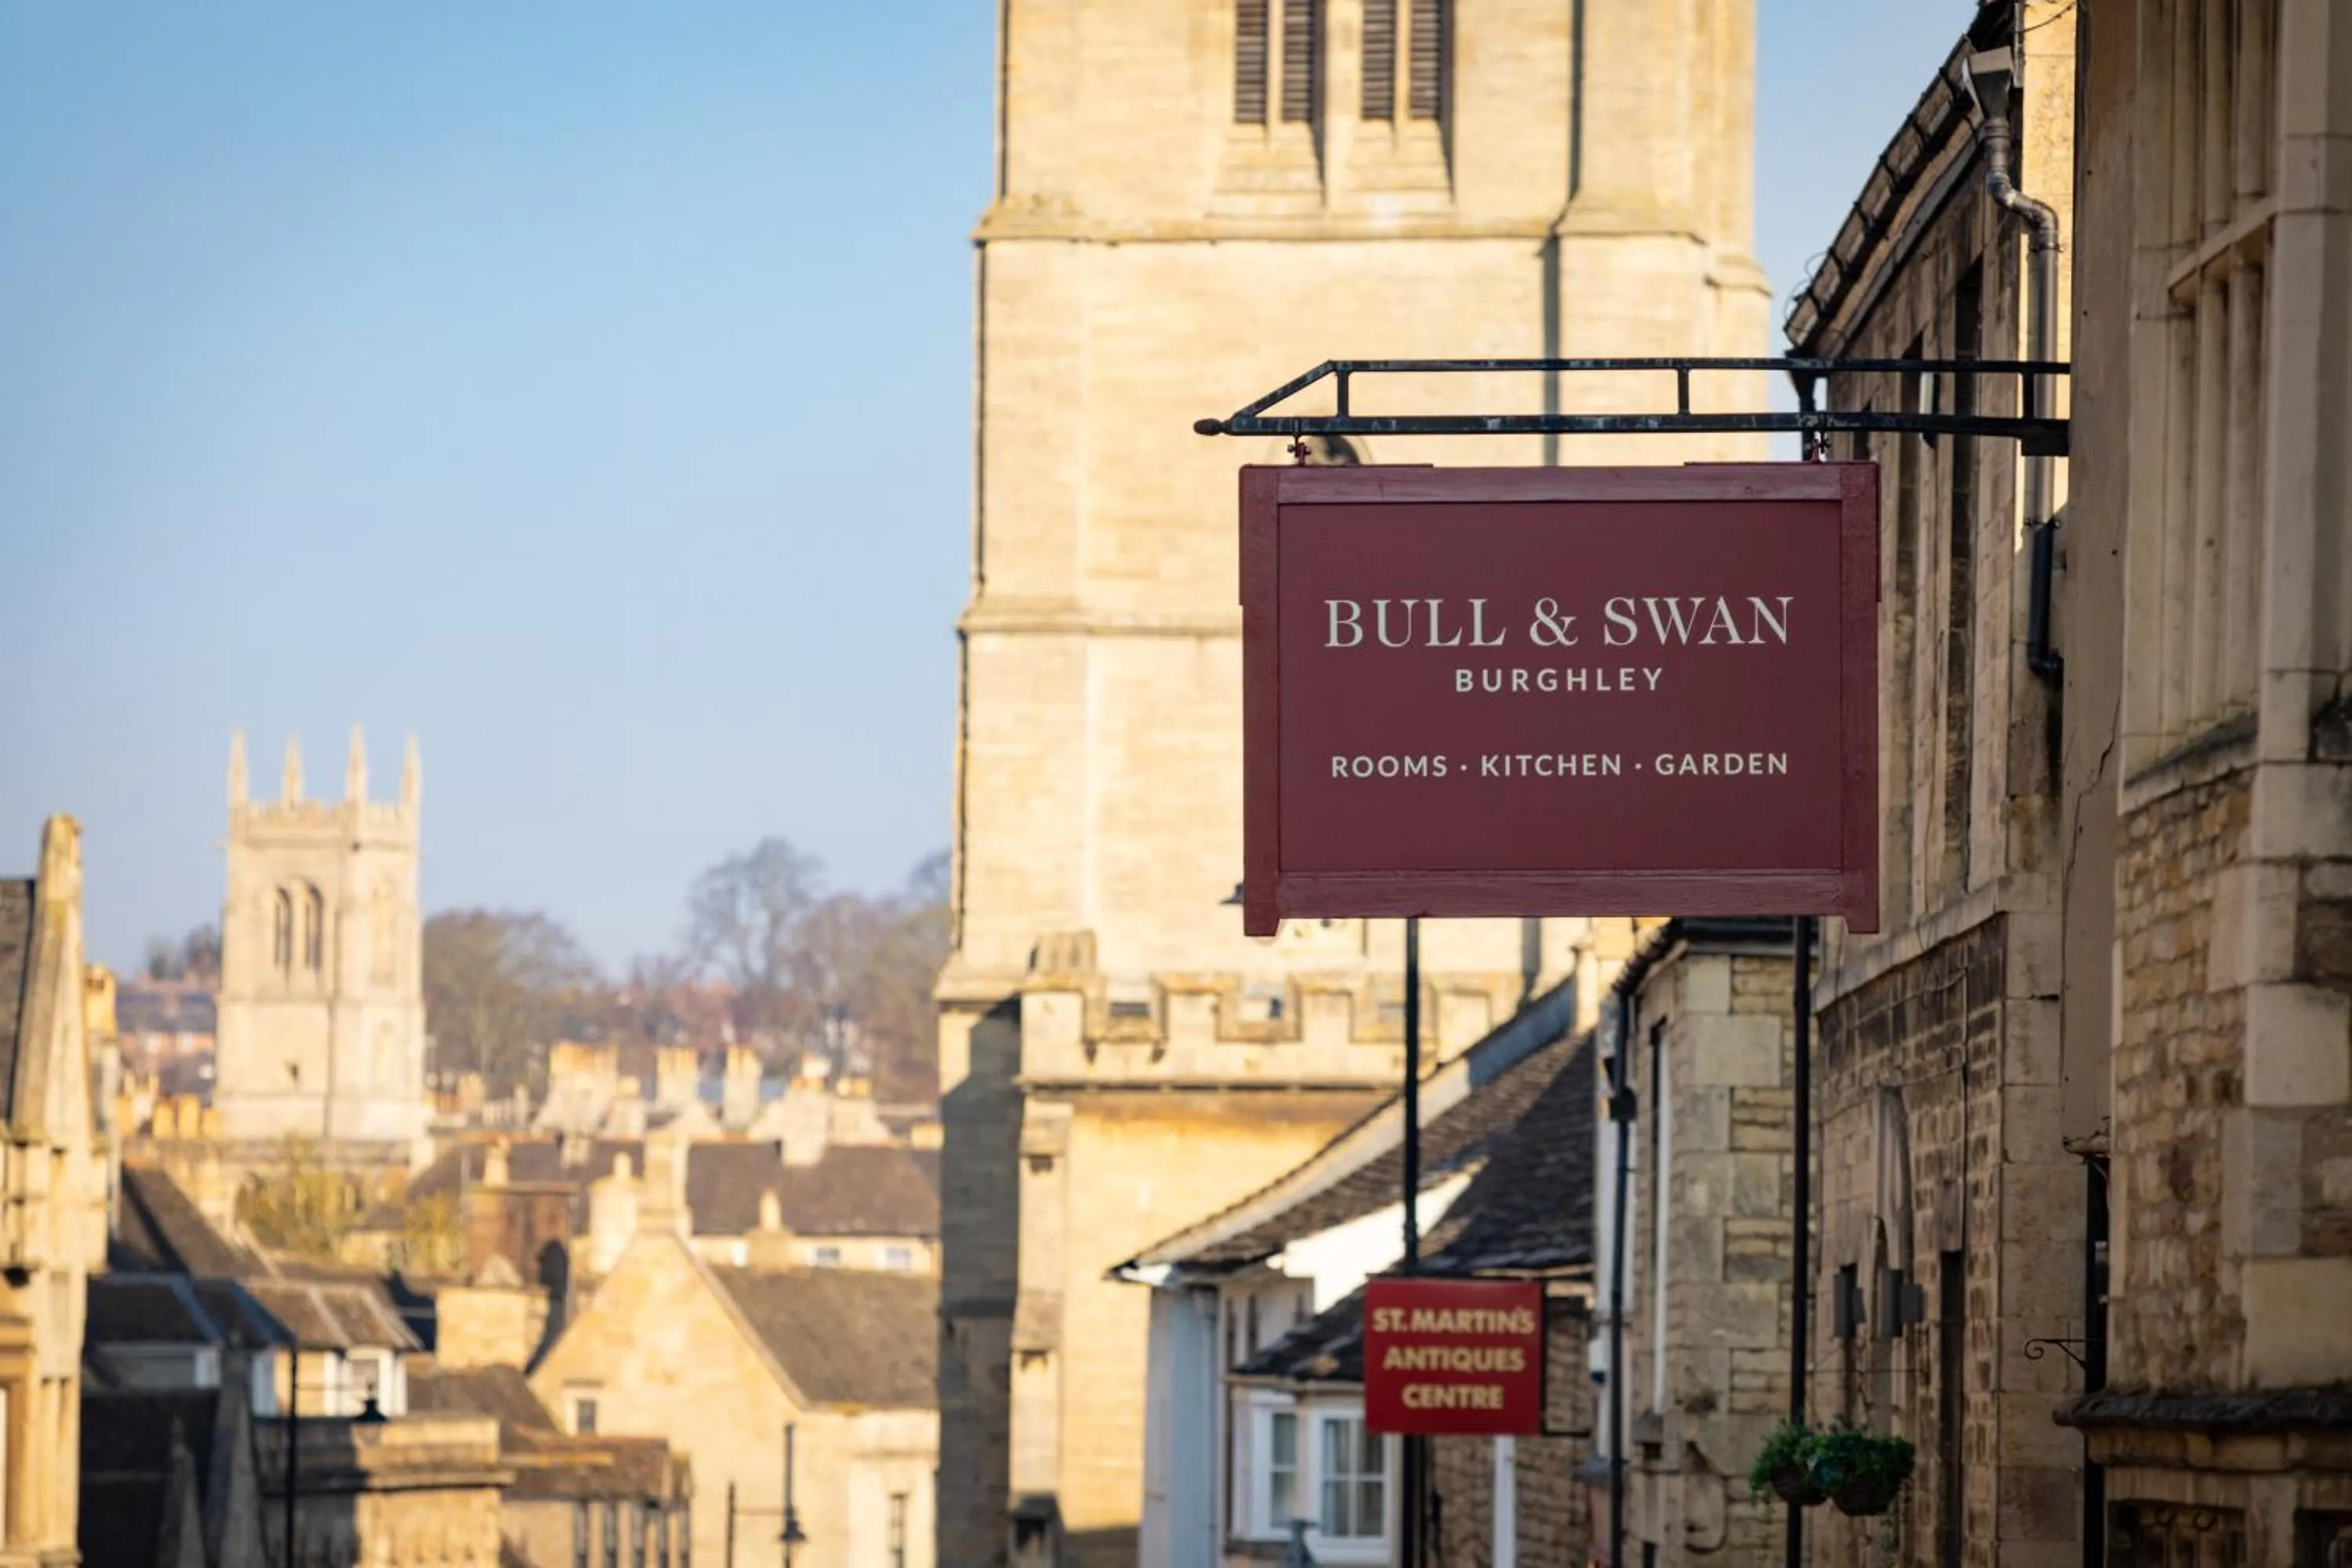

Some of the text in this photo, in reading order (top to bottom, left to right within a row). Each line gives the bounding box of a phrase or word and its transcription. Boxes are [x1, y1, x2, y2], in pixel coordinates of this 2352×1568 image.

[1324, 596, 1795, 648] BULL & SWAN
[1456, 667, 1663, 693] BURGHLEY
[1331, 753, 1788, 778] ROOMS KITCHEN GARDEN
[1383, 1345, 1526, 1373] ANTIQUES
[1401, 1384, 1504, 1409] CENTRE
